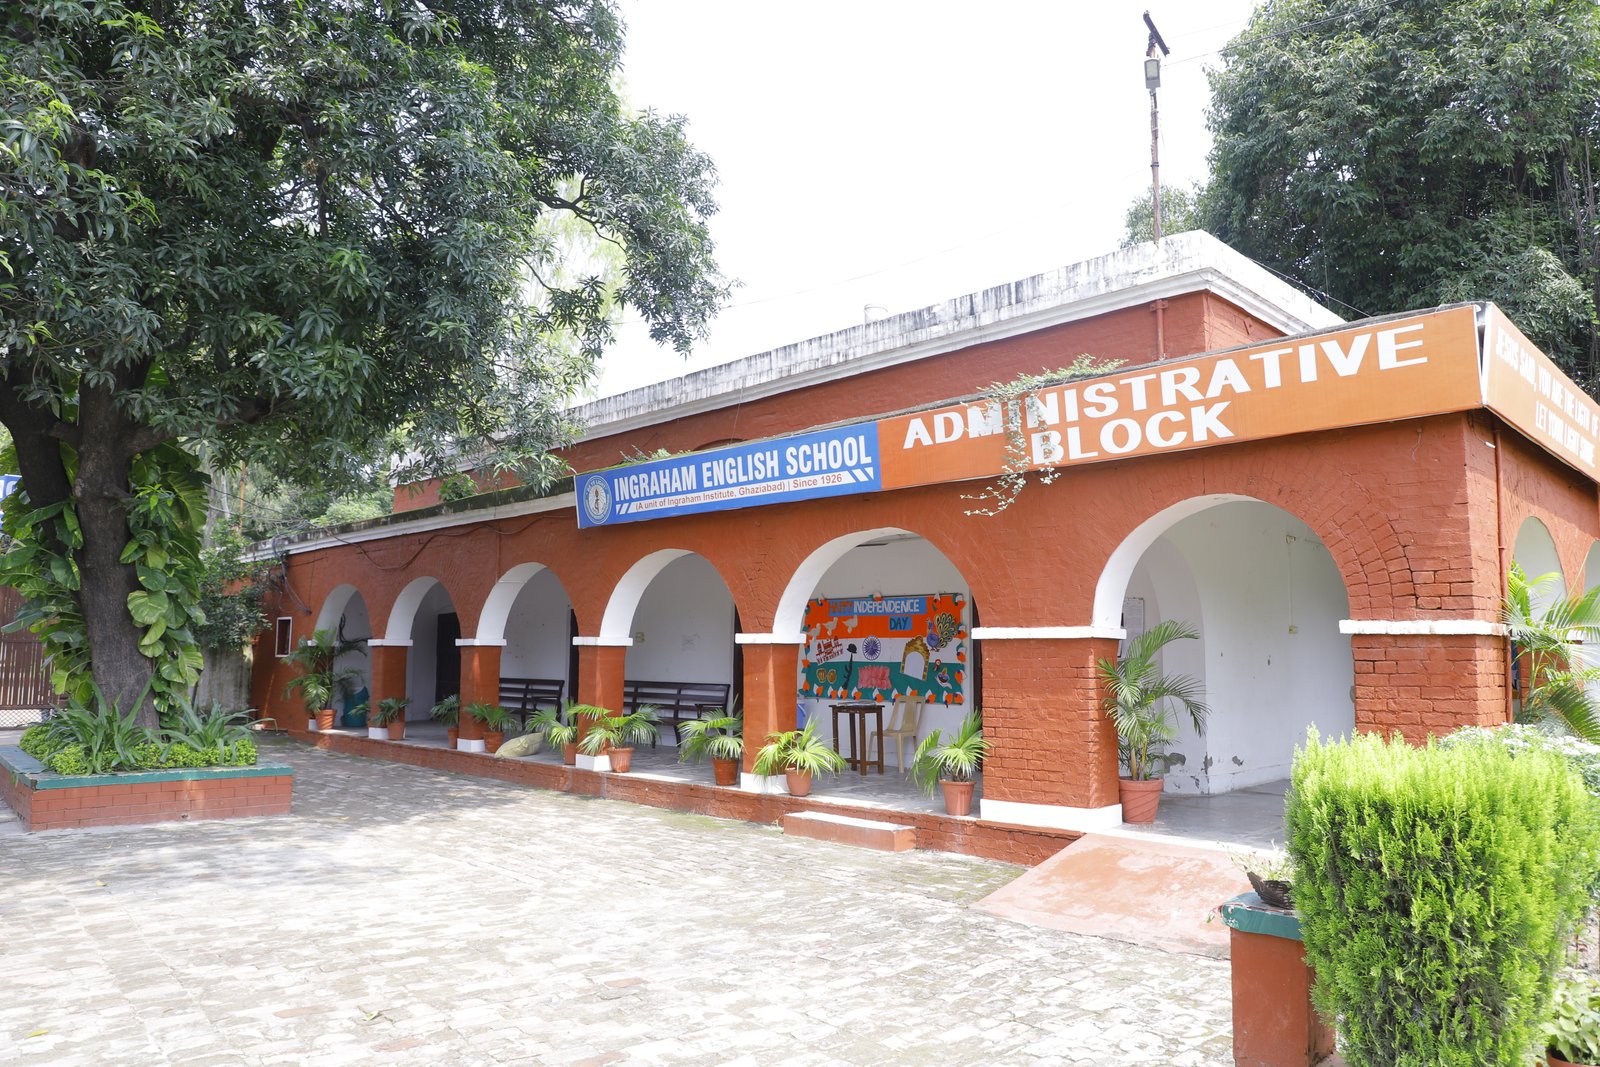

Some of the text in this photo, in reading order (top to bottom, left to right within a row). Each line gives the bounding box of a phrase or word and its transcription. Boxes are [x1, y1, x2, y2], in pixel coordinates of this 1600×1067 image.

[902, 323, 1428, 449] ADMINISTRATIVE
[1496, 326, 1519, 371] JESUS
[1538, 365, 1551, 399] YOU
[1564, 387, 1575, 419] THE
[1031, 400, 1235, 465] BLOCK
[1535, 400, 1548, 433] LET
[614, 464, 697, 501] INGRAHAM
[702, 449, 779, 488] ENGLISH
[785, 435, 872, 476] SCHOOL
[635, 502, 643, 512] (A
[645, 501, 658, 509] unit
[667, 495, 701, 507] Ingraham
[738, 482, 786, 497] Ghaziabad)
[792, 478, 818, 489] Since
[821, 473, 843, 485] 1926
[829, 599, 920, 614] HAPPY INDEPENDENCE
[889, 617, 908, 631] DAY
